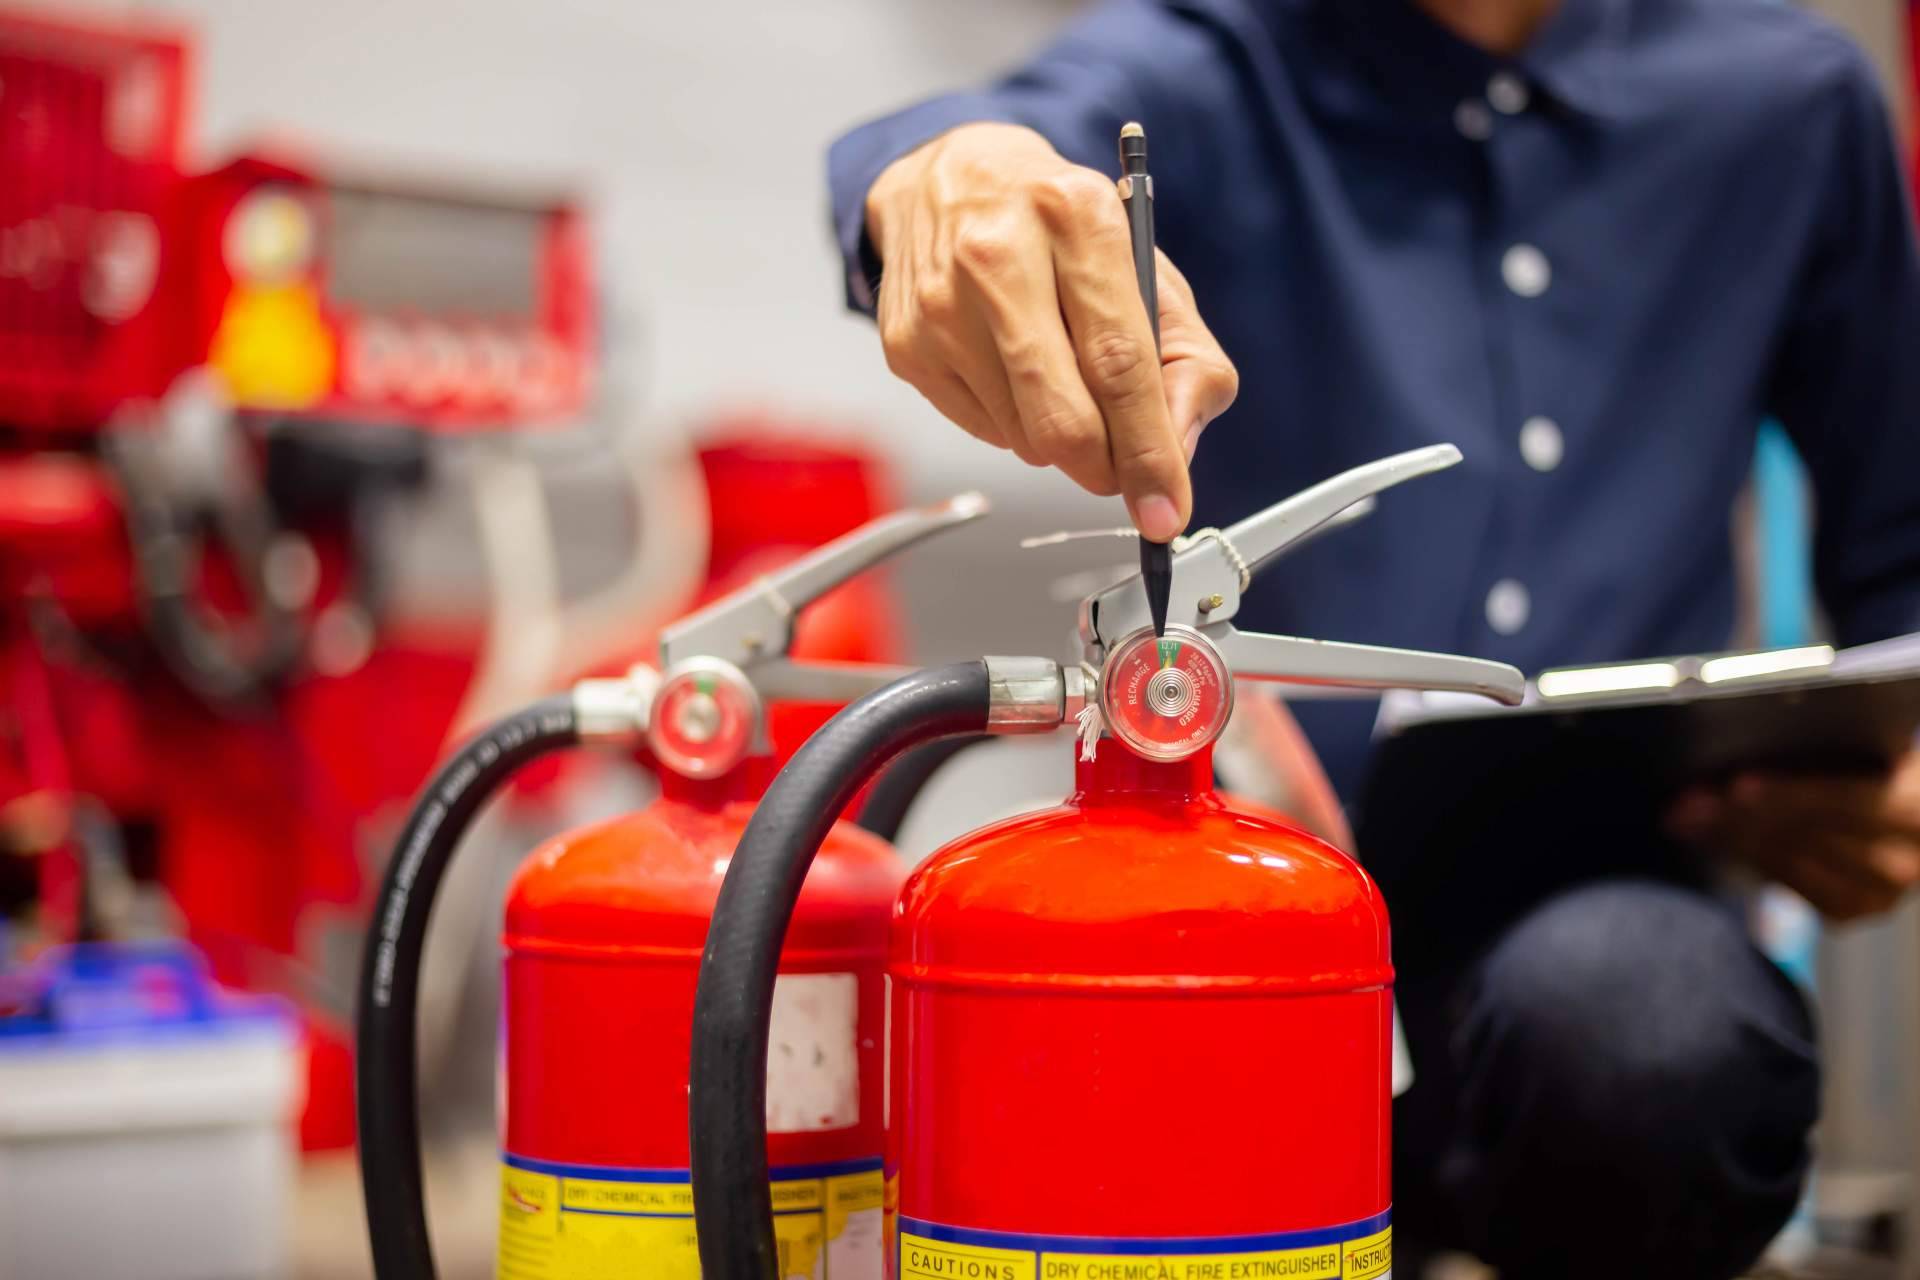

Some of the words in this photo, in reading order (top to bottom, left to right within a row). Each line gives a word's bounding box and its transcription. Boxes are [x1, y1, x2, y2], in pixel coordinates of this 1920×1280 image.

[1128, 662, 1151, 706] RECHARGE
[1179, 667, 1202, 728] OVERCHARGED
[911, 1251, 1015, 1280] CAUTIONS
[1047, 1261, 1081, 1279] DRY
[1087, 1263, 1177, 1280] CHEMICAL
[1186, 1263, 1224, 1280] FIRE
[1231, 1252, 1335, 1279] EXTINGUISHER
